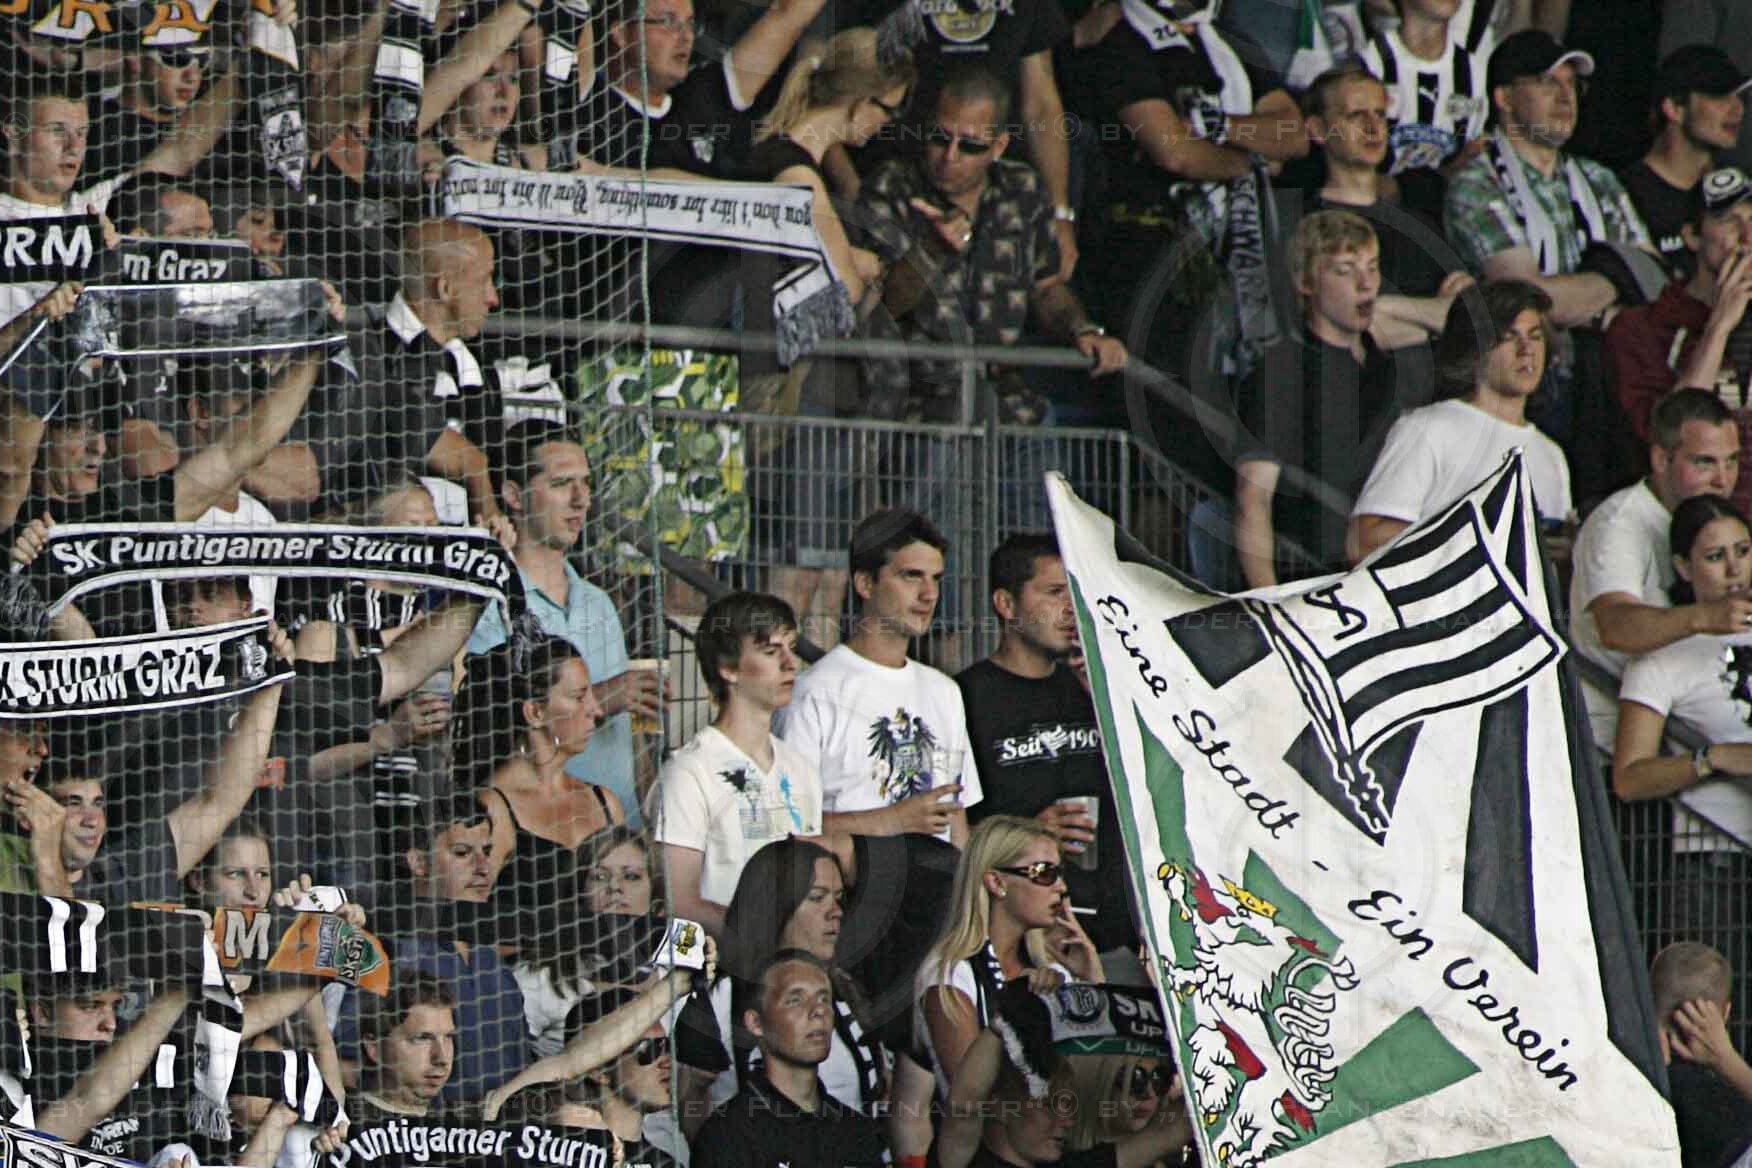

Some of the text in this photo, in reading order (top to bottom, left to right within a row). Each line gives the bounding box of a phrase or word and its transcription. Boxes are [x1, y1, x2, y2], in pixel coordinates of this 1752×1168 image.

[157, 248, 229, 281] Graz
[52, 534, 512, 588] SK Puntigamer Sturm Graz
[22, 653, 129, 703] STURM
[135, 641, 225, 697] GRAZ
[1096, 594, 1170, 701] Eine
[1171, 707, 1297, 841] Stadt
[1346, 886, 1434, 962] Ein
[1443, 954, 1582, 1094] Verein
